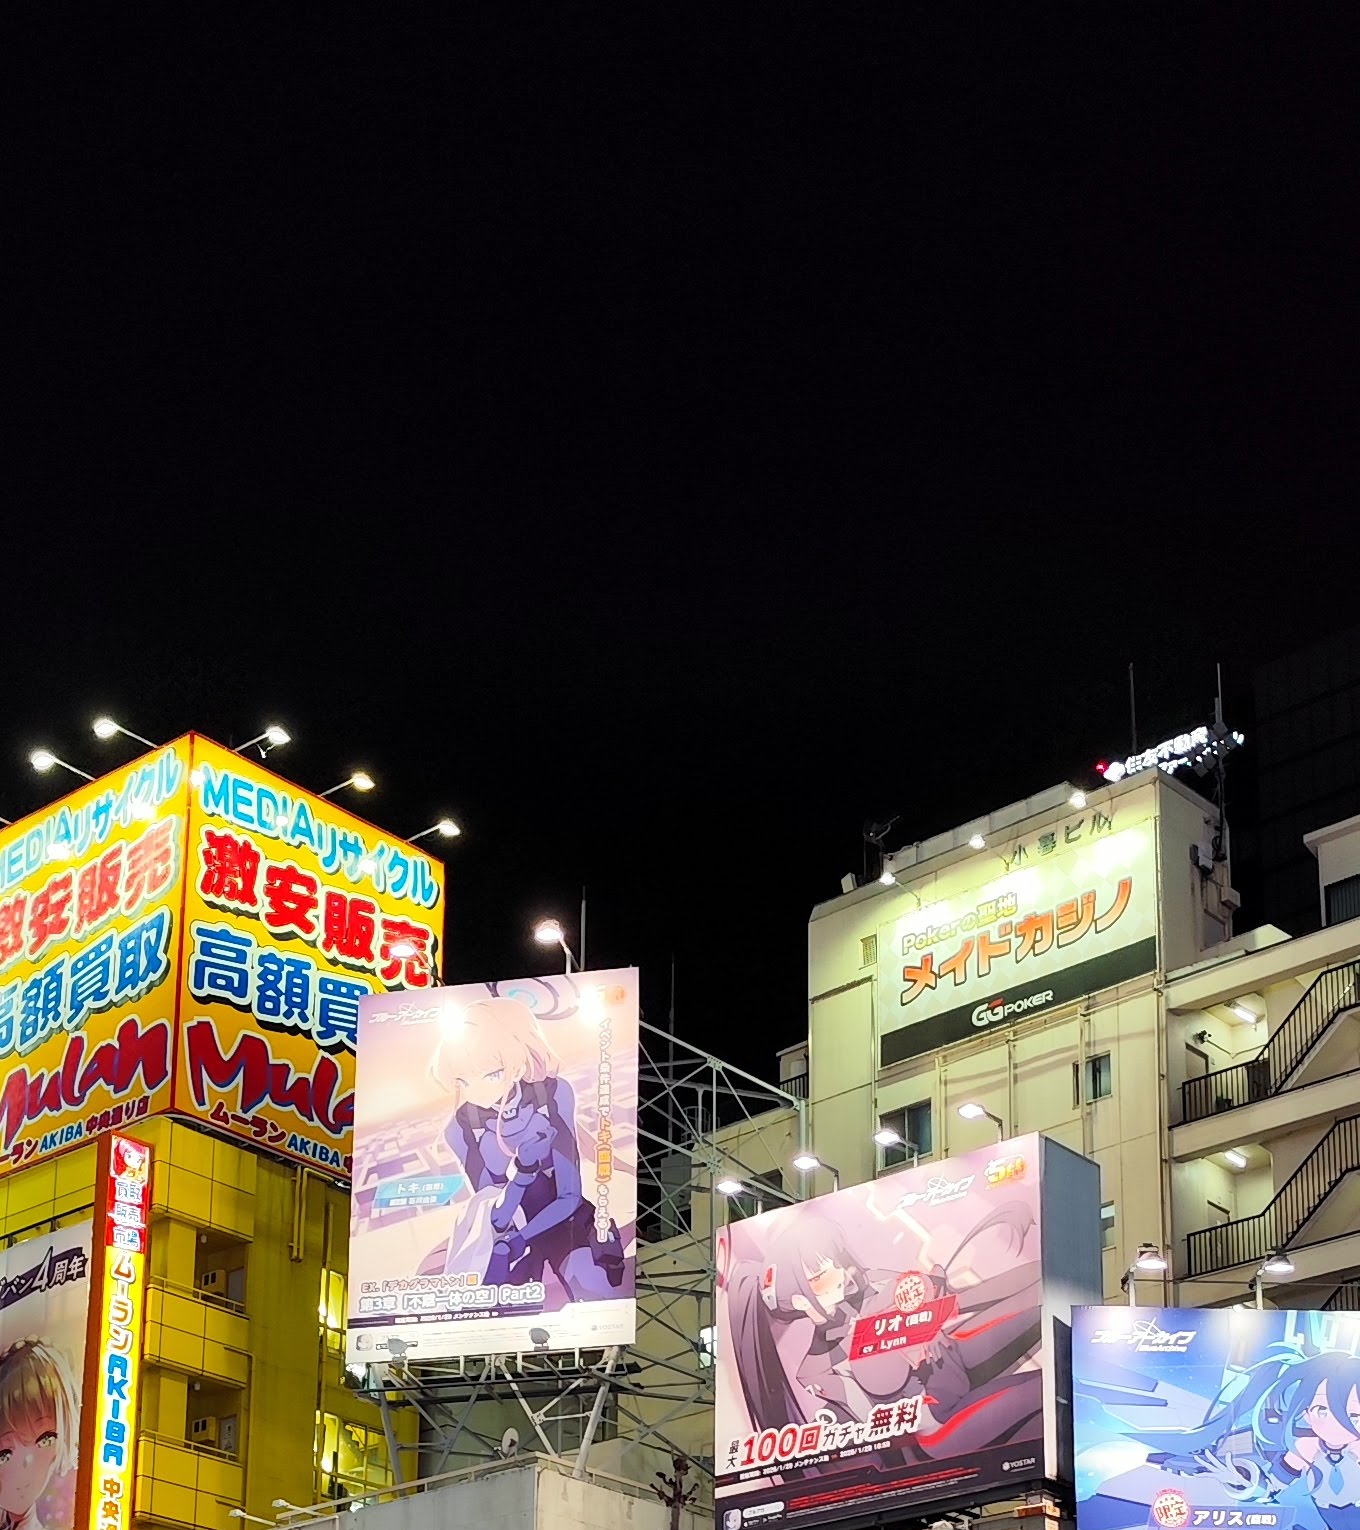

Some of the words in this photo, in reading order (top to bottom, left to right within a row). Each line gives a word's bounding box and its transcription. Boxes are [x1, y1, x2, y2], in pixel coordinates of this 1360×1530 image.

[199, 766, 439, 906] MEDIAリサイクル
[199, 830, 435, 988] 激安販売
[899, 876, 1134, 1007] メイドカジノ
[39, 1122, 84, 1153] AKIBA
[210, 1103, 286, 1145] ムーラン
[286, 1132, 341, 1170] AKIBA
[501, 1283, 545, 1304] Part2
[880, 1336, 907, 1351] Lynn
[102, 1354, 130, 1467] AKIBA
